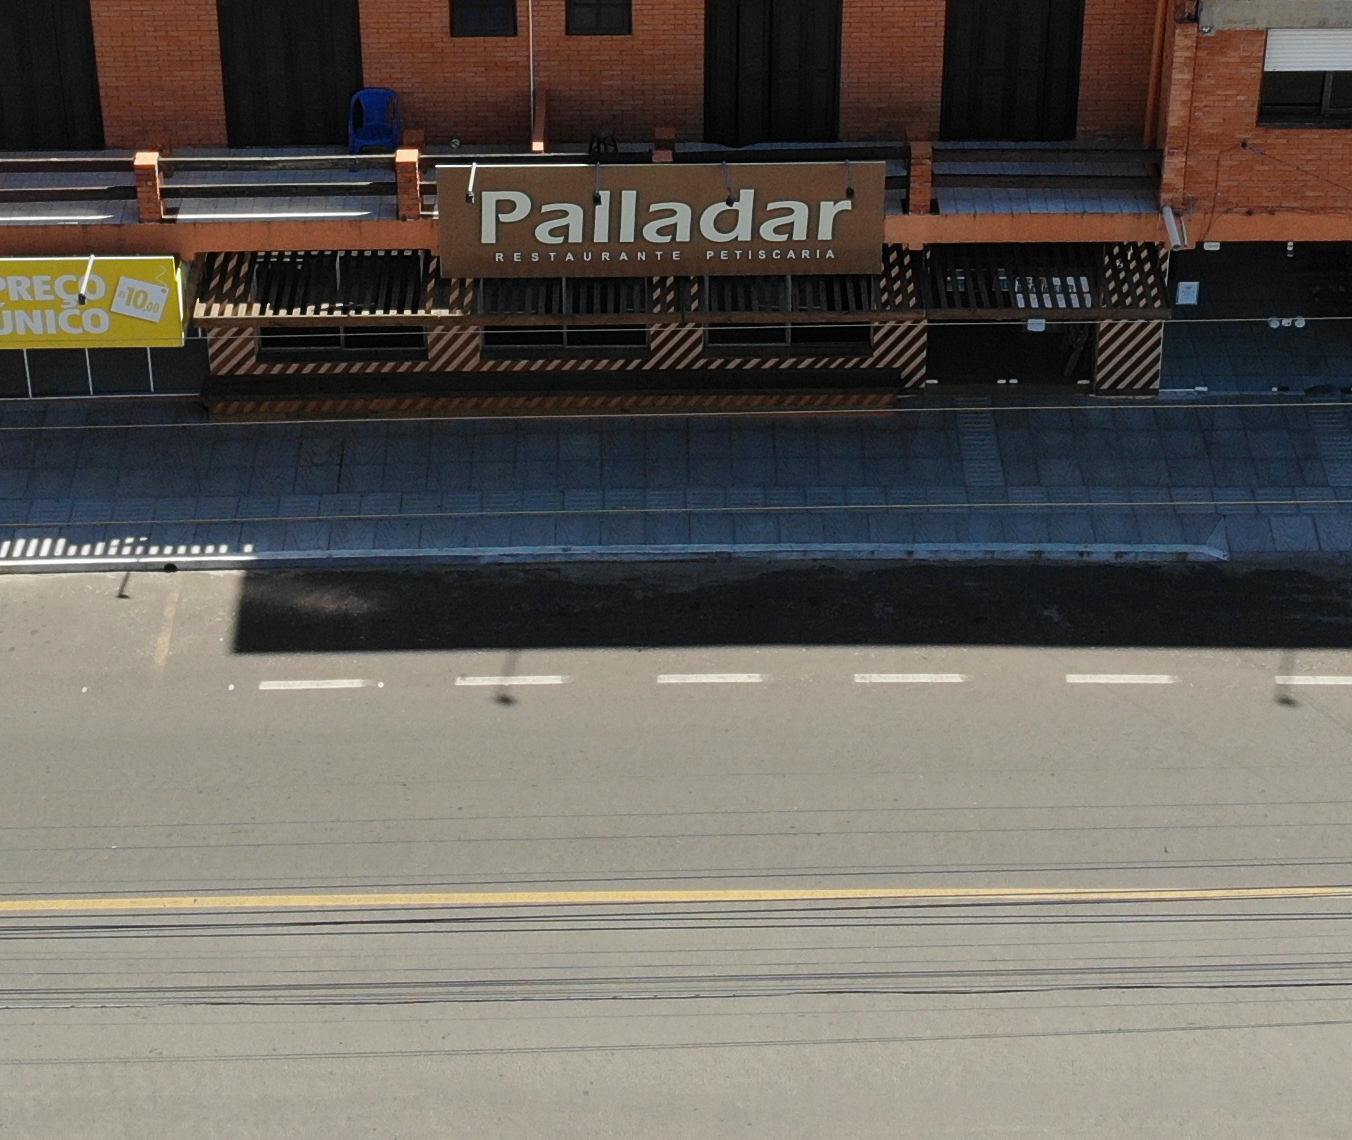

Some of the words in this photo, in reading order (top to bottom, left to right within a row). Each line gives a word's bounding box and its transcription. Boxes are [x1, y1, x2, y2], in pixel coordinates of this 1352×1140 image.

[481, 189, 852, 244] Palladar
[495, 251, 681, 262] RESTAURANTE
[706, 249, 835, 260] PETISCARIA
